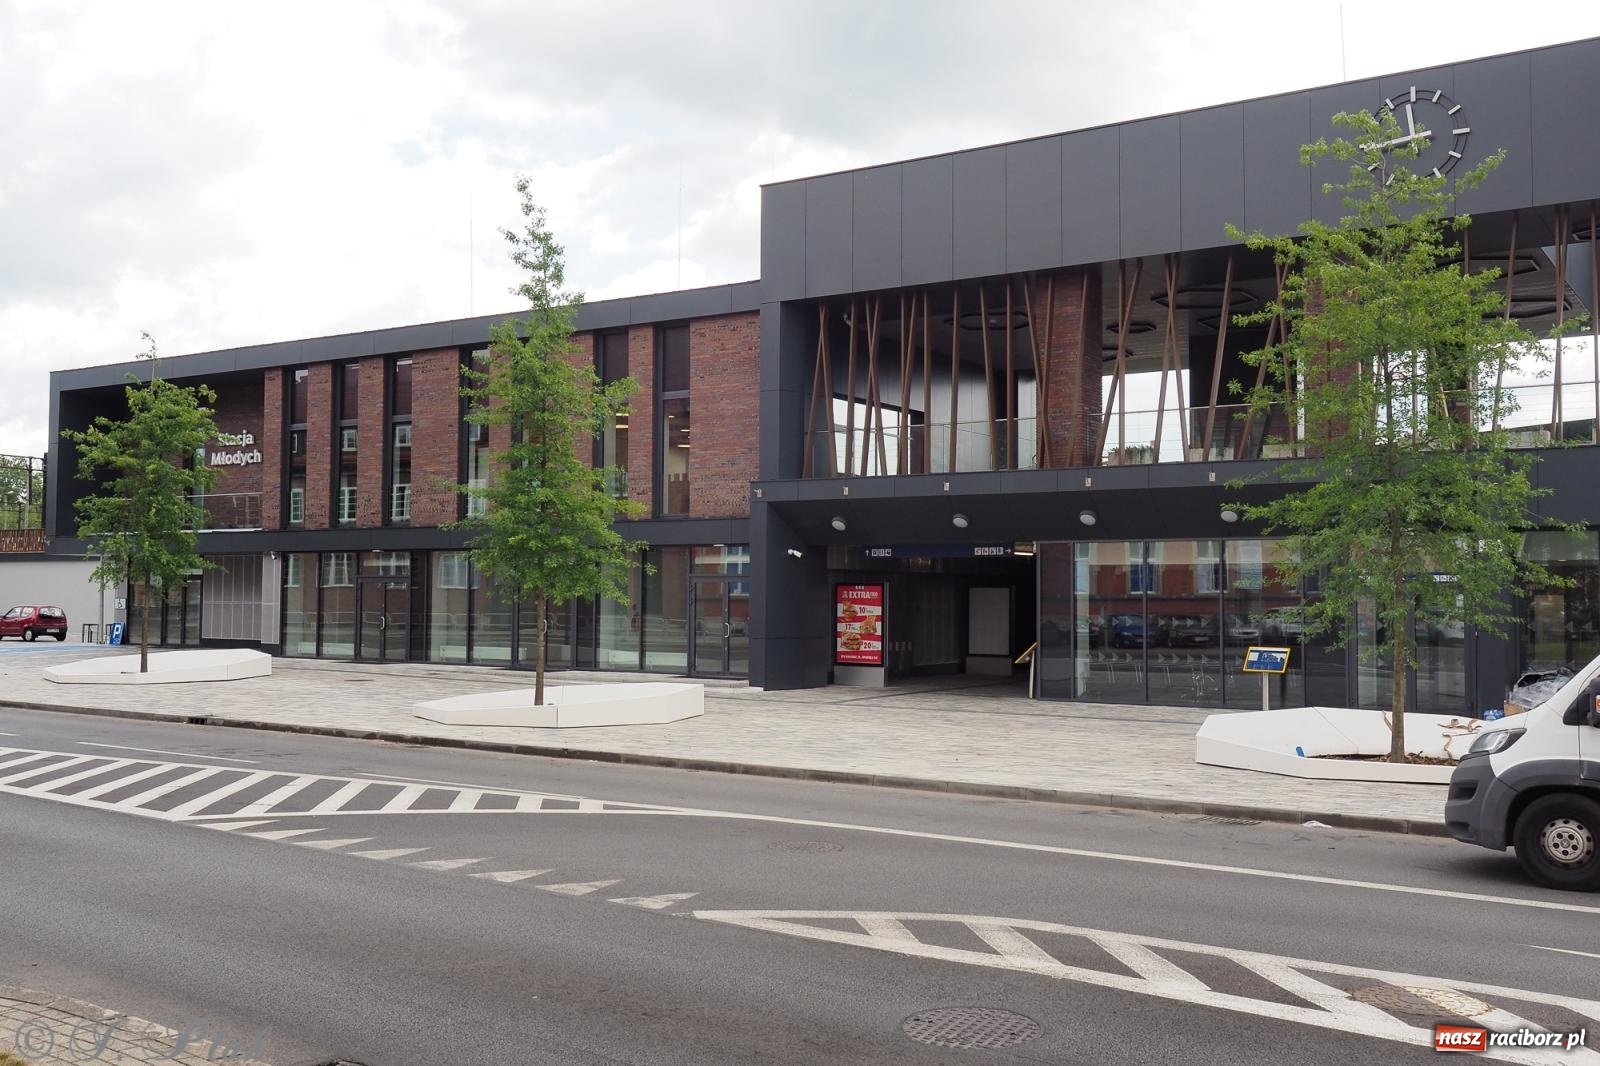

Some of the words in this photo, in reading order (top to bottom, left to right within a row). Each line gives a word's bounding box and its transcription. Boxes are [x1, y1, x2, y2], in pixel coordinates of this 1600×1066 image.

[218, 429, 254, 447] Stacja
[211, 449, 262, 467] Młodych
[849, 591, 870, 599] EXTRA
[113, 624, 121, 638] P
